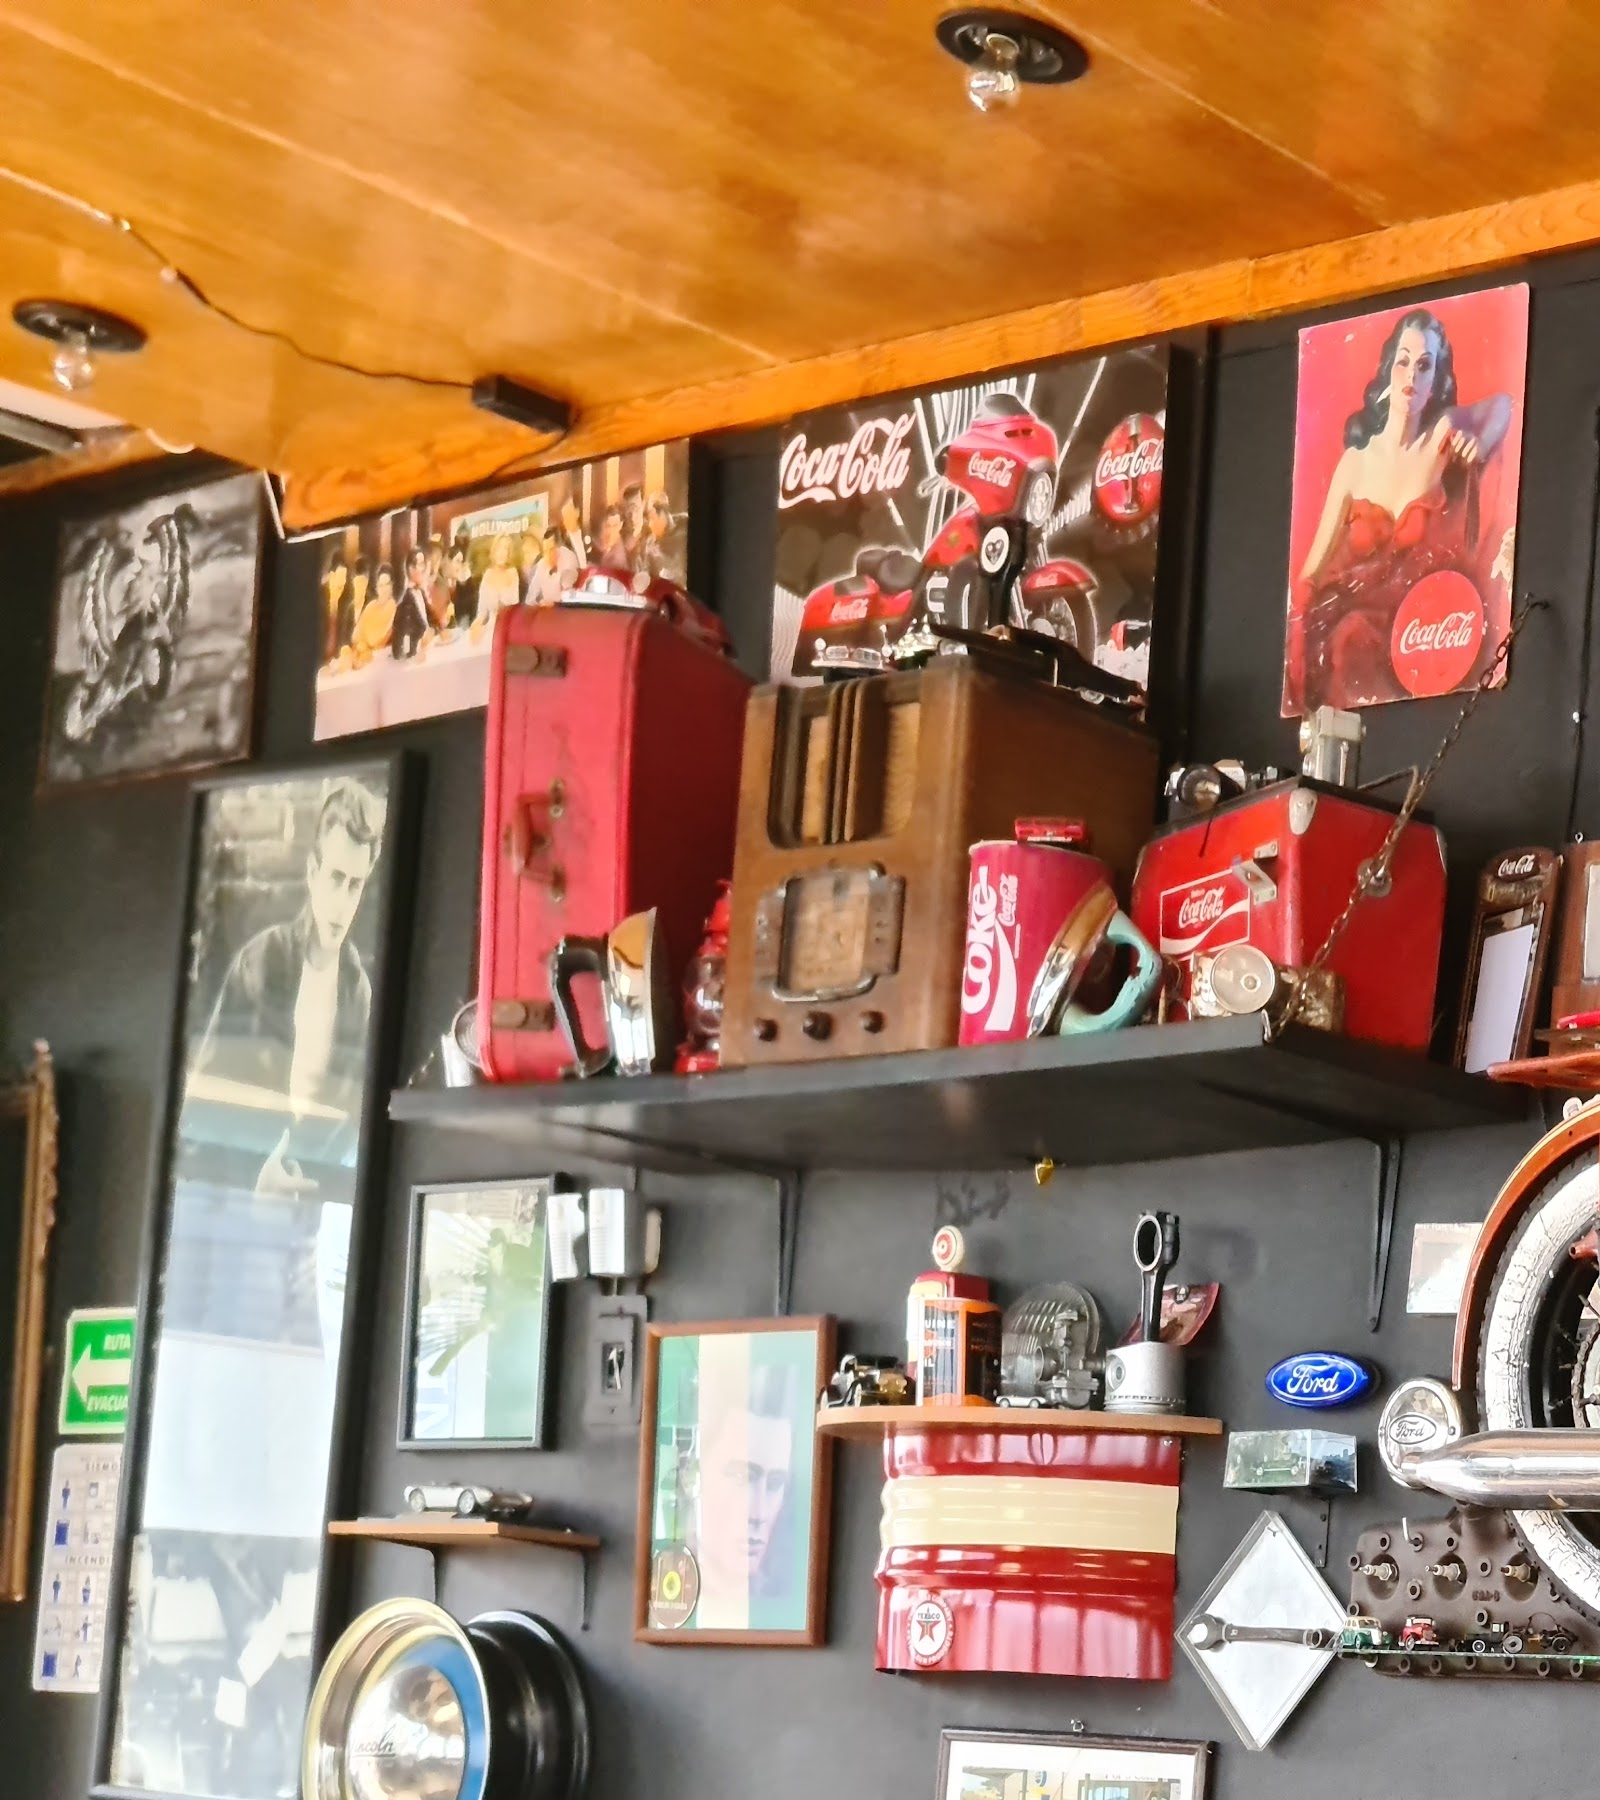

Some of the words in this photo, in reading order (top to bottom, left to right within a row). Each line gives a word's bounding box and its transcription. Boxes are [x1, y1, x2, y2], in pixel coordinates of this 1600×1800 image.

[777, 411, 918, 509] Coca-Cola
[967, 451, 1017, 488] Coca-Cola
[1400, 610, 1476, 655] Coca-Cola
[1178, 885, 1227, 930] Coca-Cola
[103, 1333, 132, 1351] RUTA
[1286, 1363, 1341, 1395] Ford
[86, 1395, 128, 1413] EVACUA
[1396, 1420, 1426, 1438] Ford
[64, 1555, 112, 1567] INCENDI
